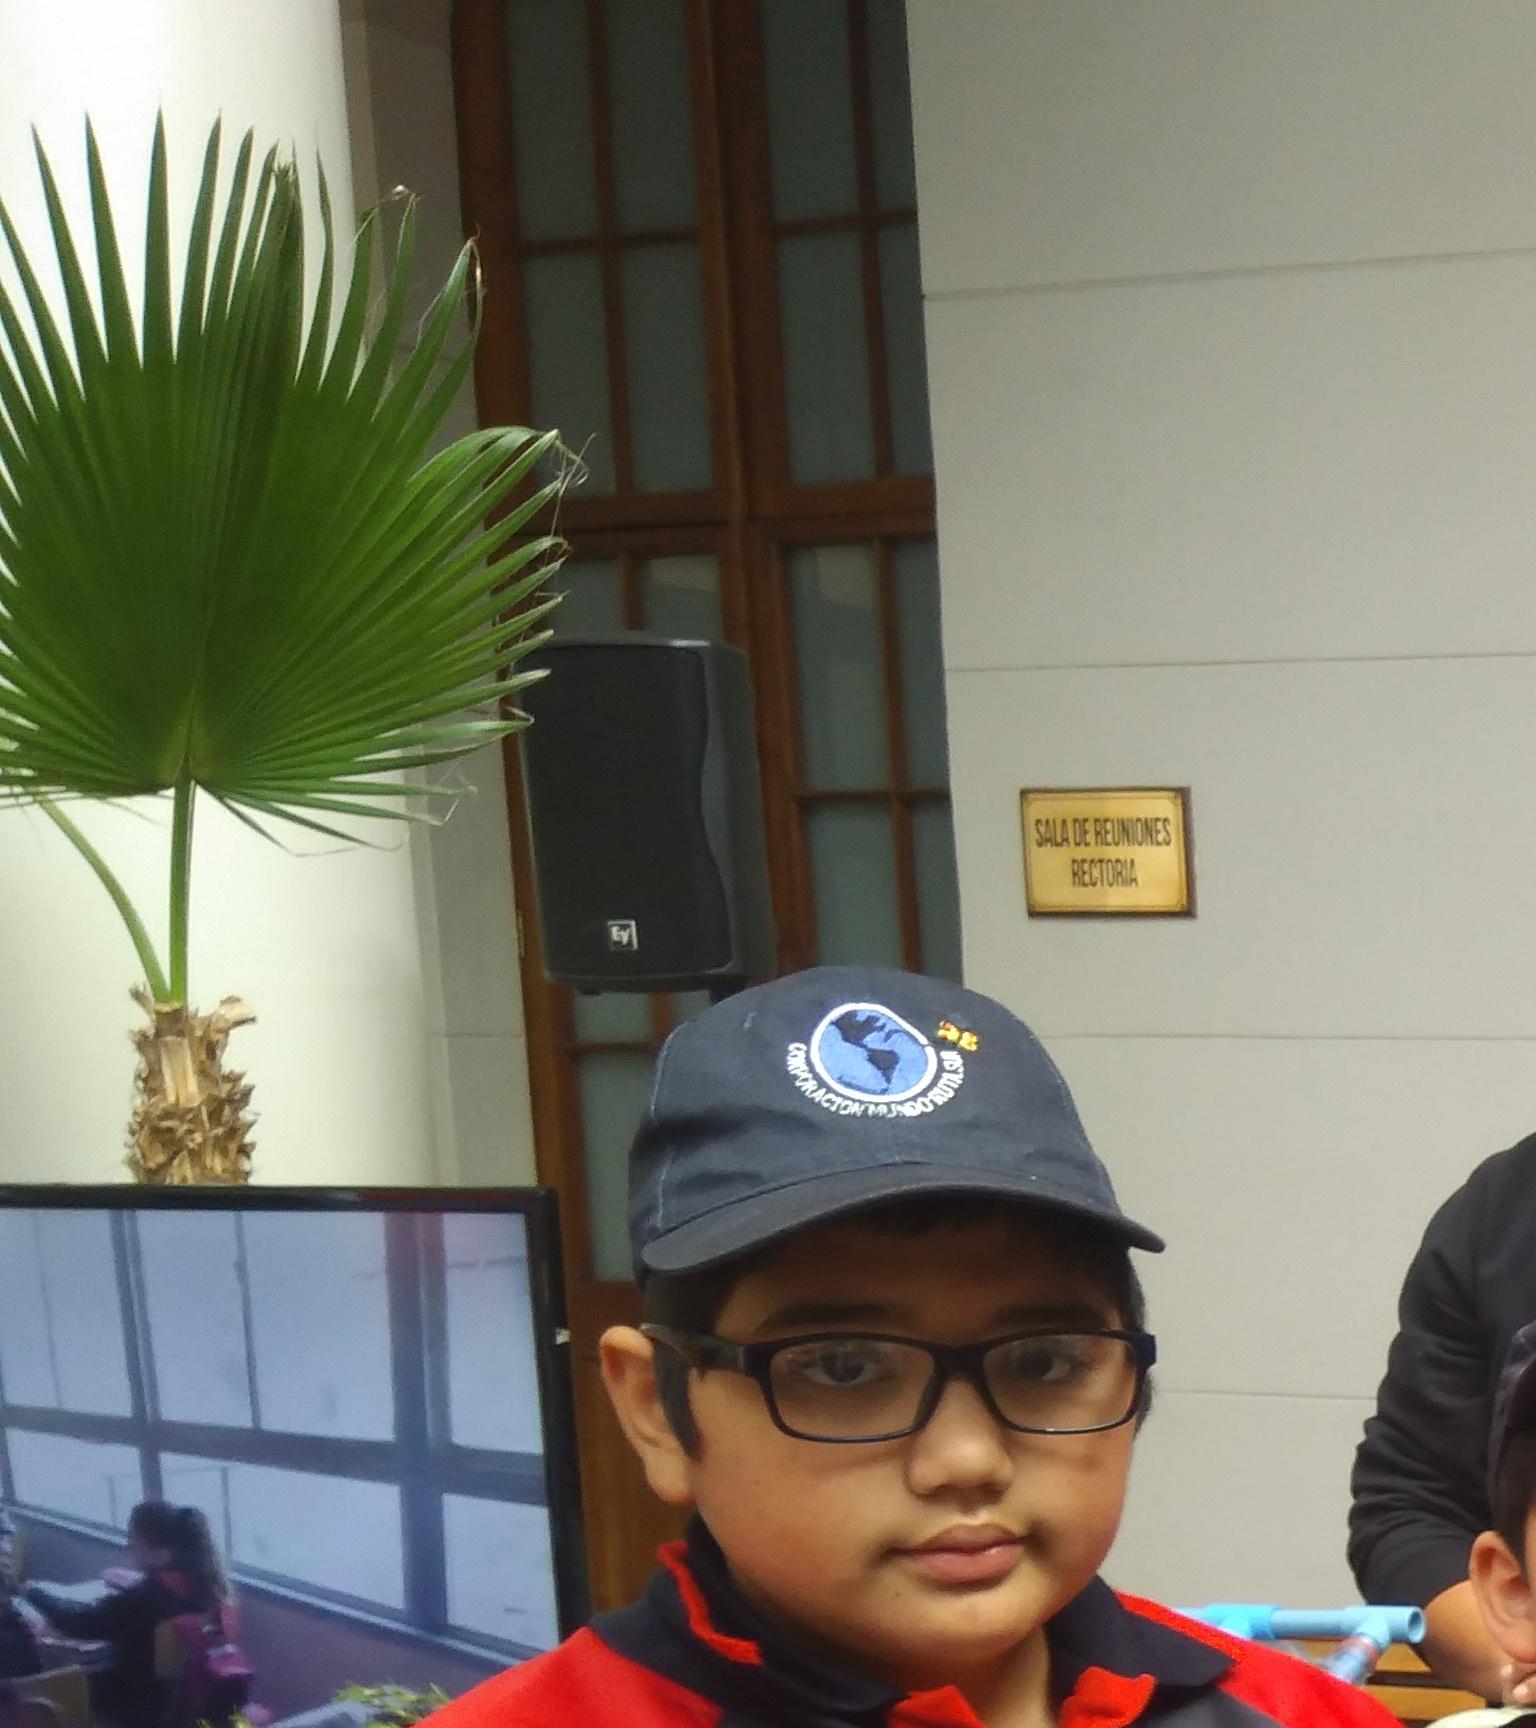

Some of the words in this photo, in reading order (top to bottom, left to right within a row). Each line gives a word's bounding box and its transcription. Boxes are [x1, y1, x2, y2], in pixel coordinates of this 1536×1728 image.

[1035, 817, 1069, 848] SALA
[1073, 817, 1091, 848] DE
[1094, 816, 1172, 848] REUNIONES
[1071, 858, 1139, 888] RECTORIA
[787, 1043, 863, 1117] CORPORACION
